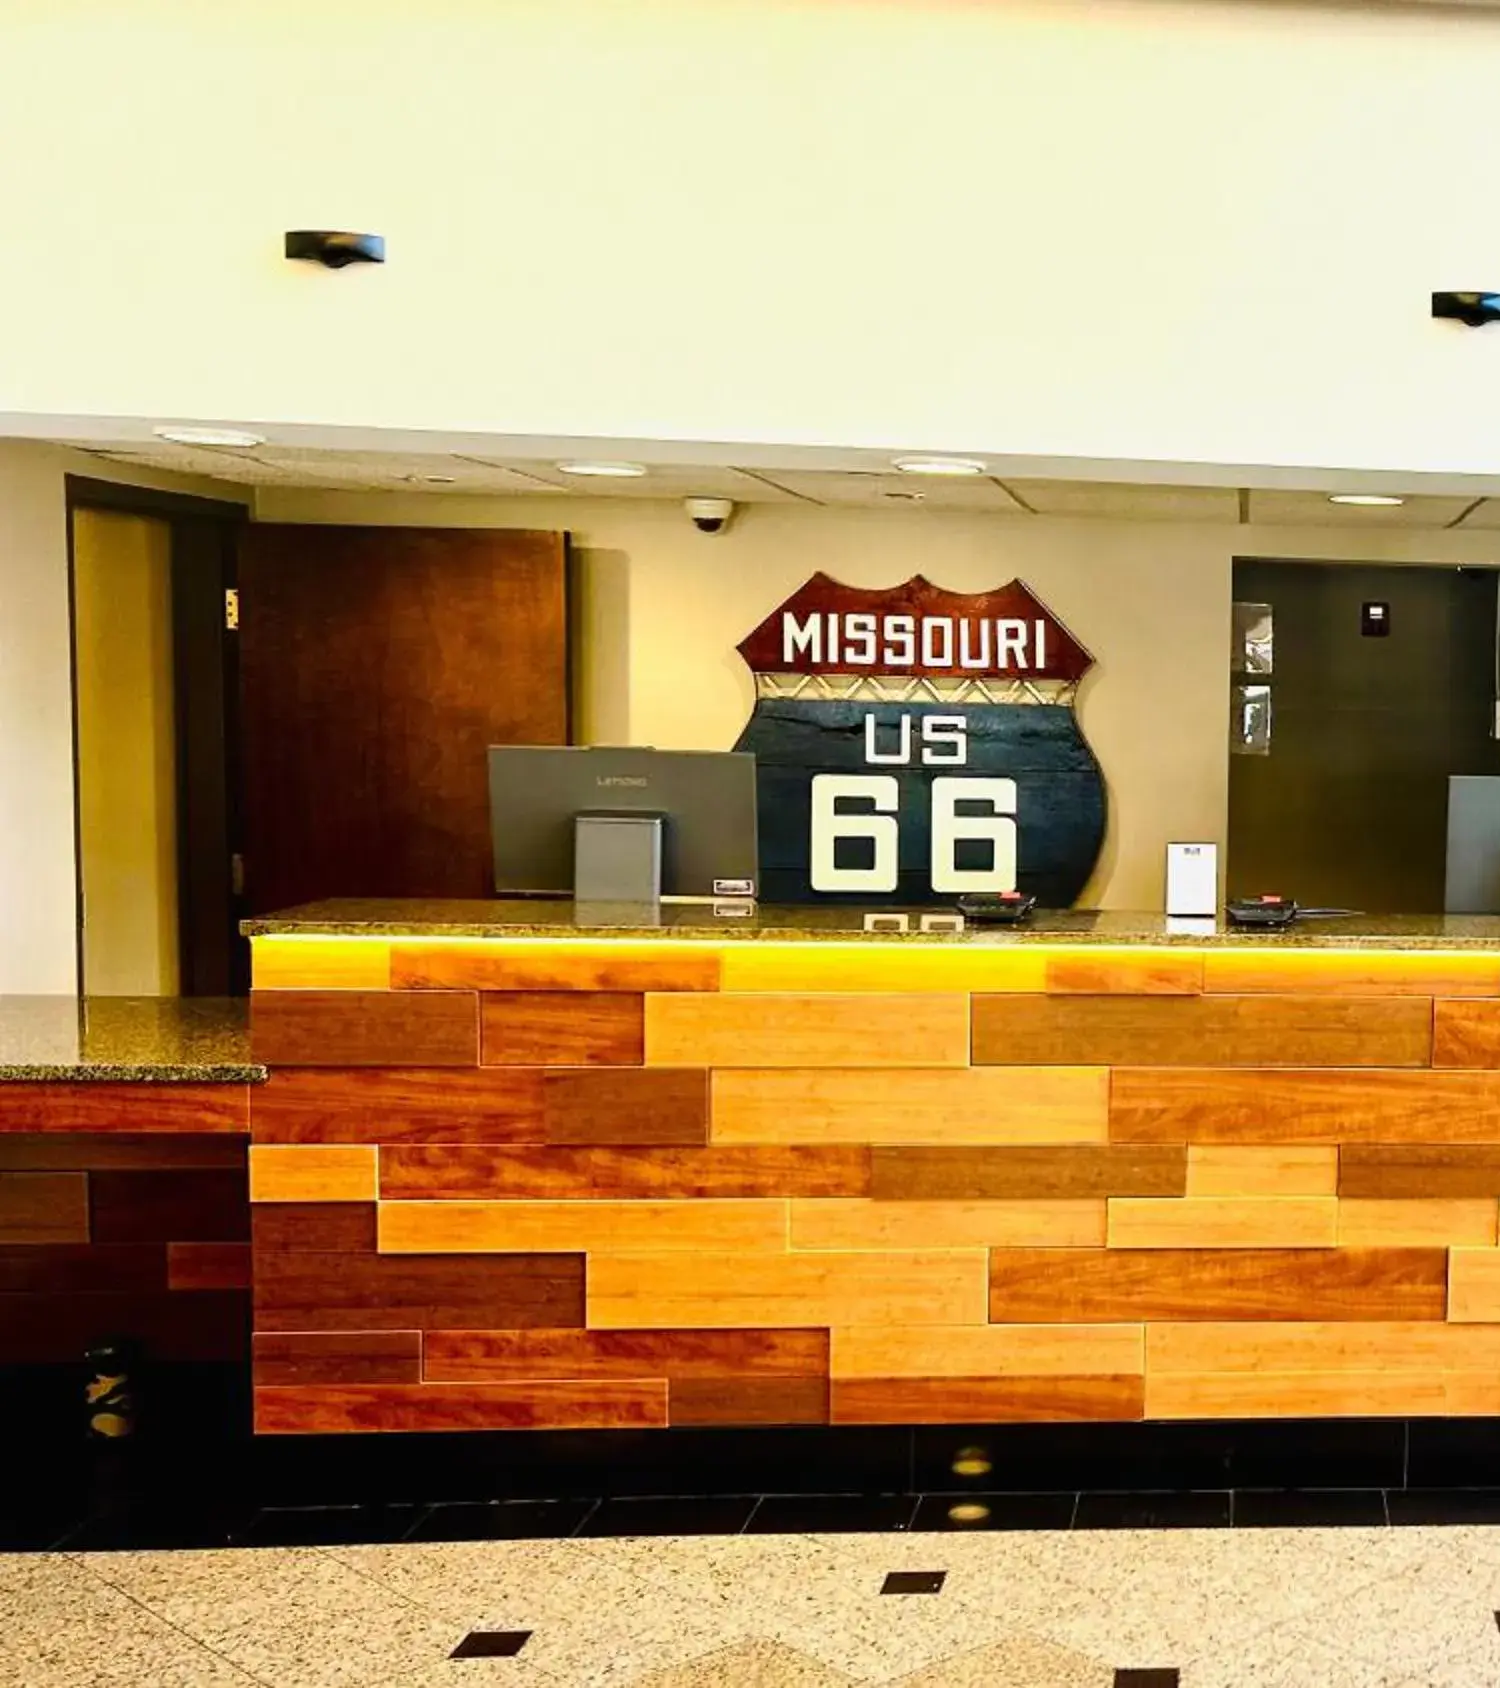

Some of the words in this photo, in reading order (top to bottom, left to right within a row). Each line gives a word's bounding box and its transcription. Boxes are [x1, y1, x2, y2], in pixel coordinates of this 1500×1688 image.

[783, 612, 1046, 669] MISSOURI
[864, 713, 967, 765] US
[810, 774, 1018, 893] 66
